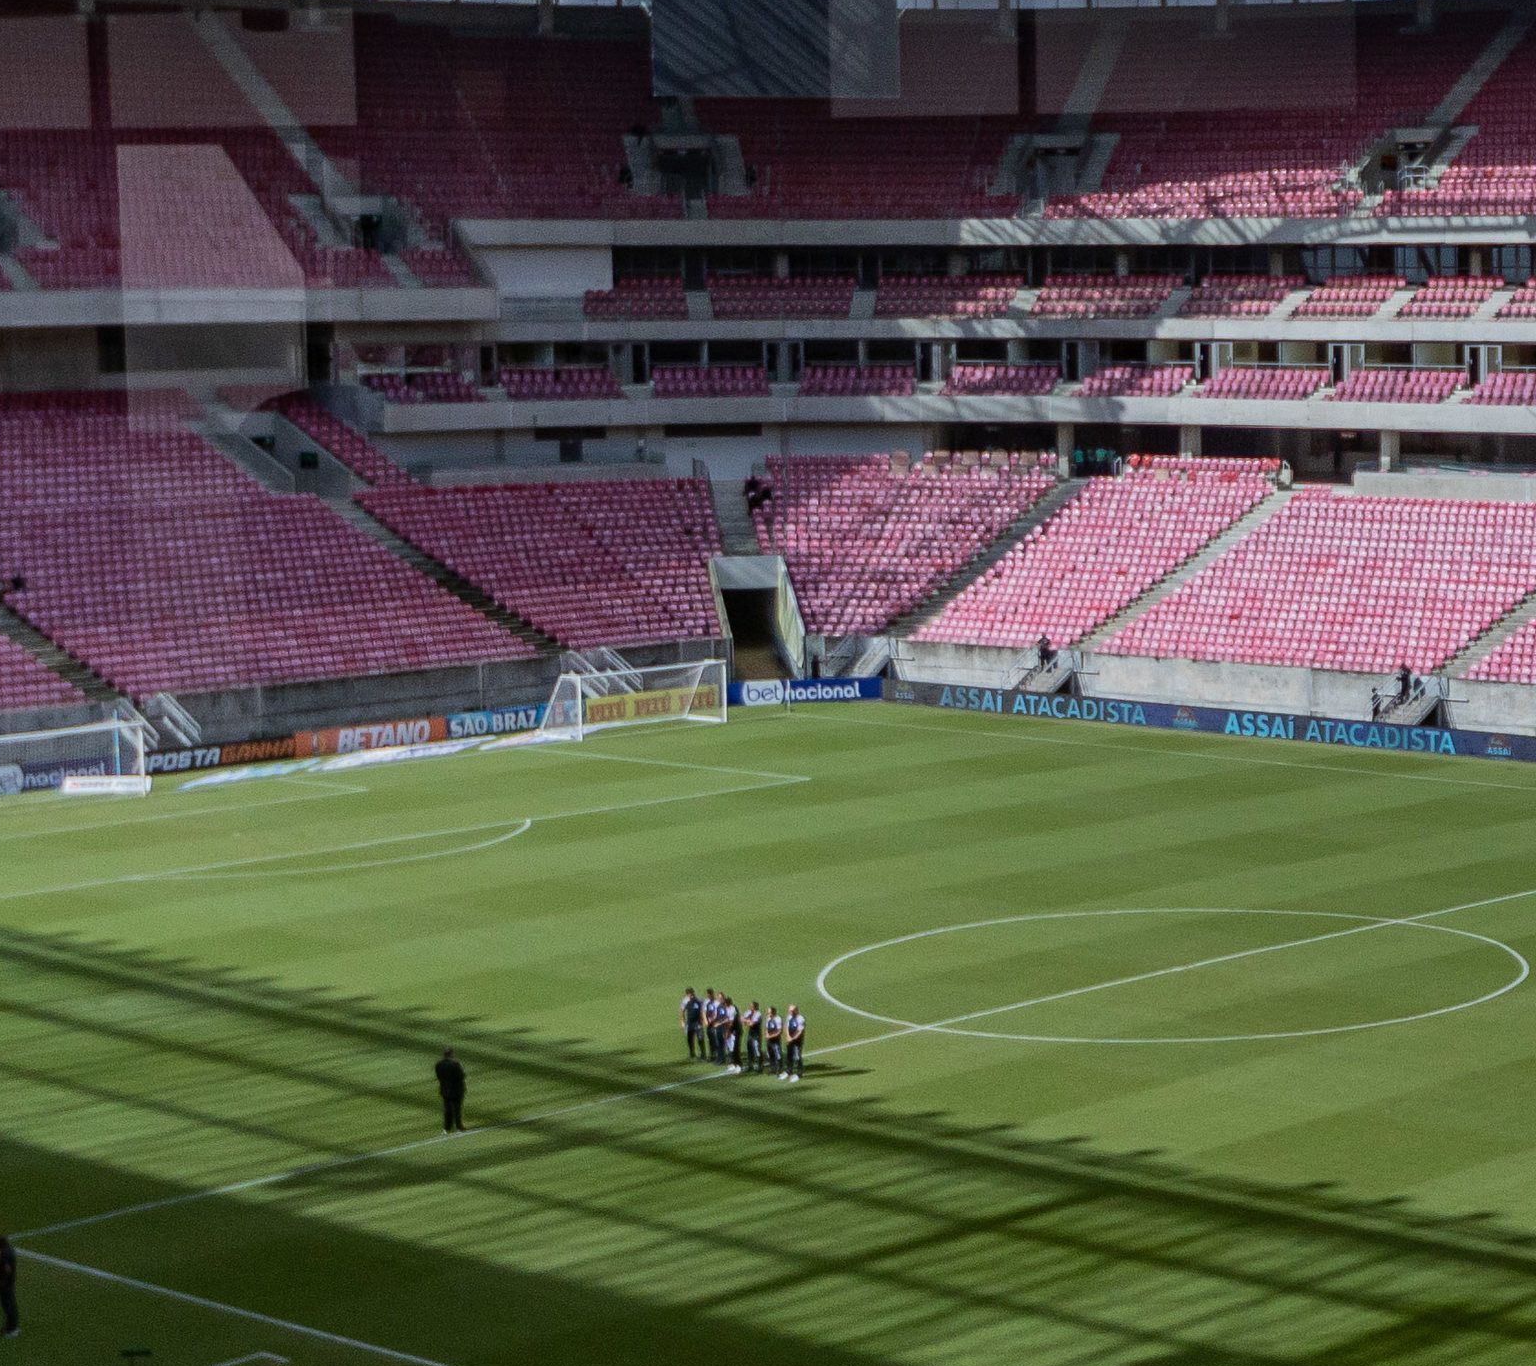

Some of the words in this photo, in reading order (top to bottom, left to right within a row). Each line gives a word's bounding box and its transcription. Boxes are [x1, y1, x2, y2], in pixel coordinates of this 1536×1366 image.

[492, 708, 538, 733] BRAZ
[1012, 693, 1146, 726] ATACADISTA
[338, 720, 430, 753] BETANO
[1305, 718, 1457, 754] ATACADISTA
